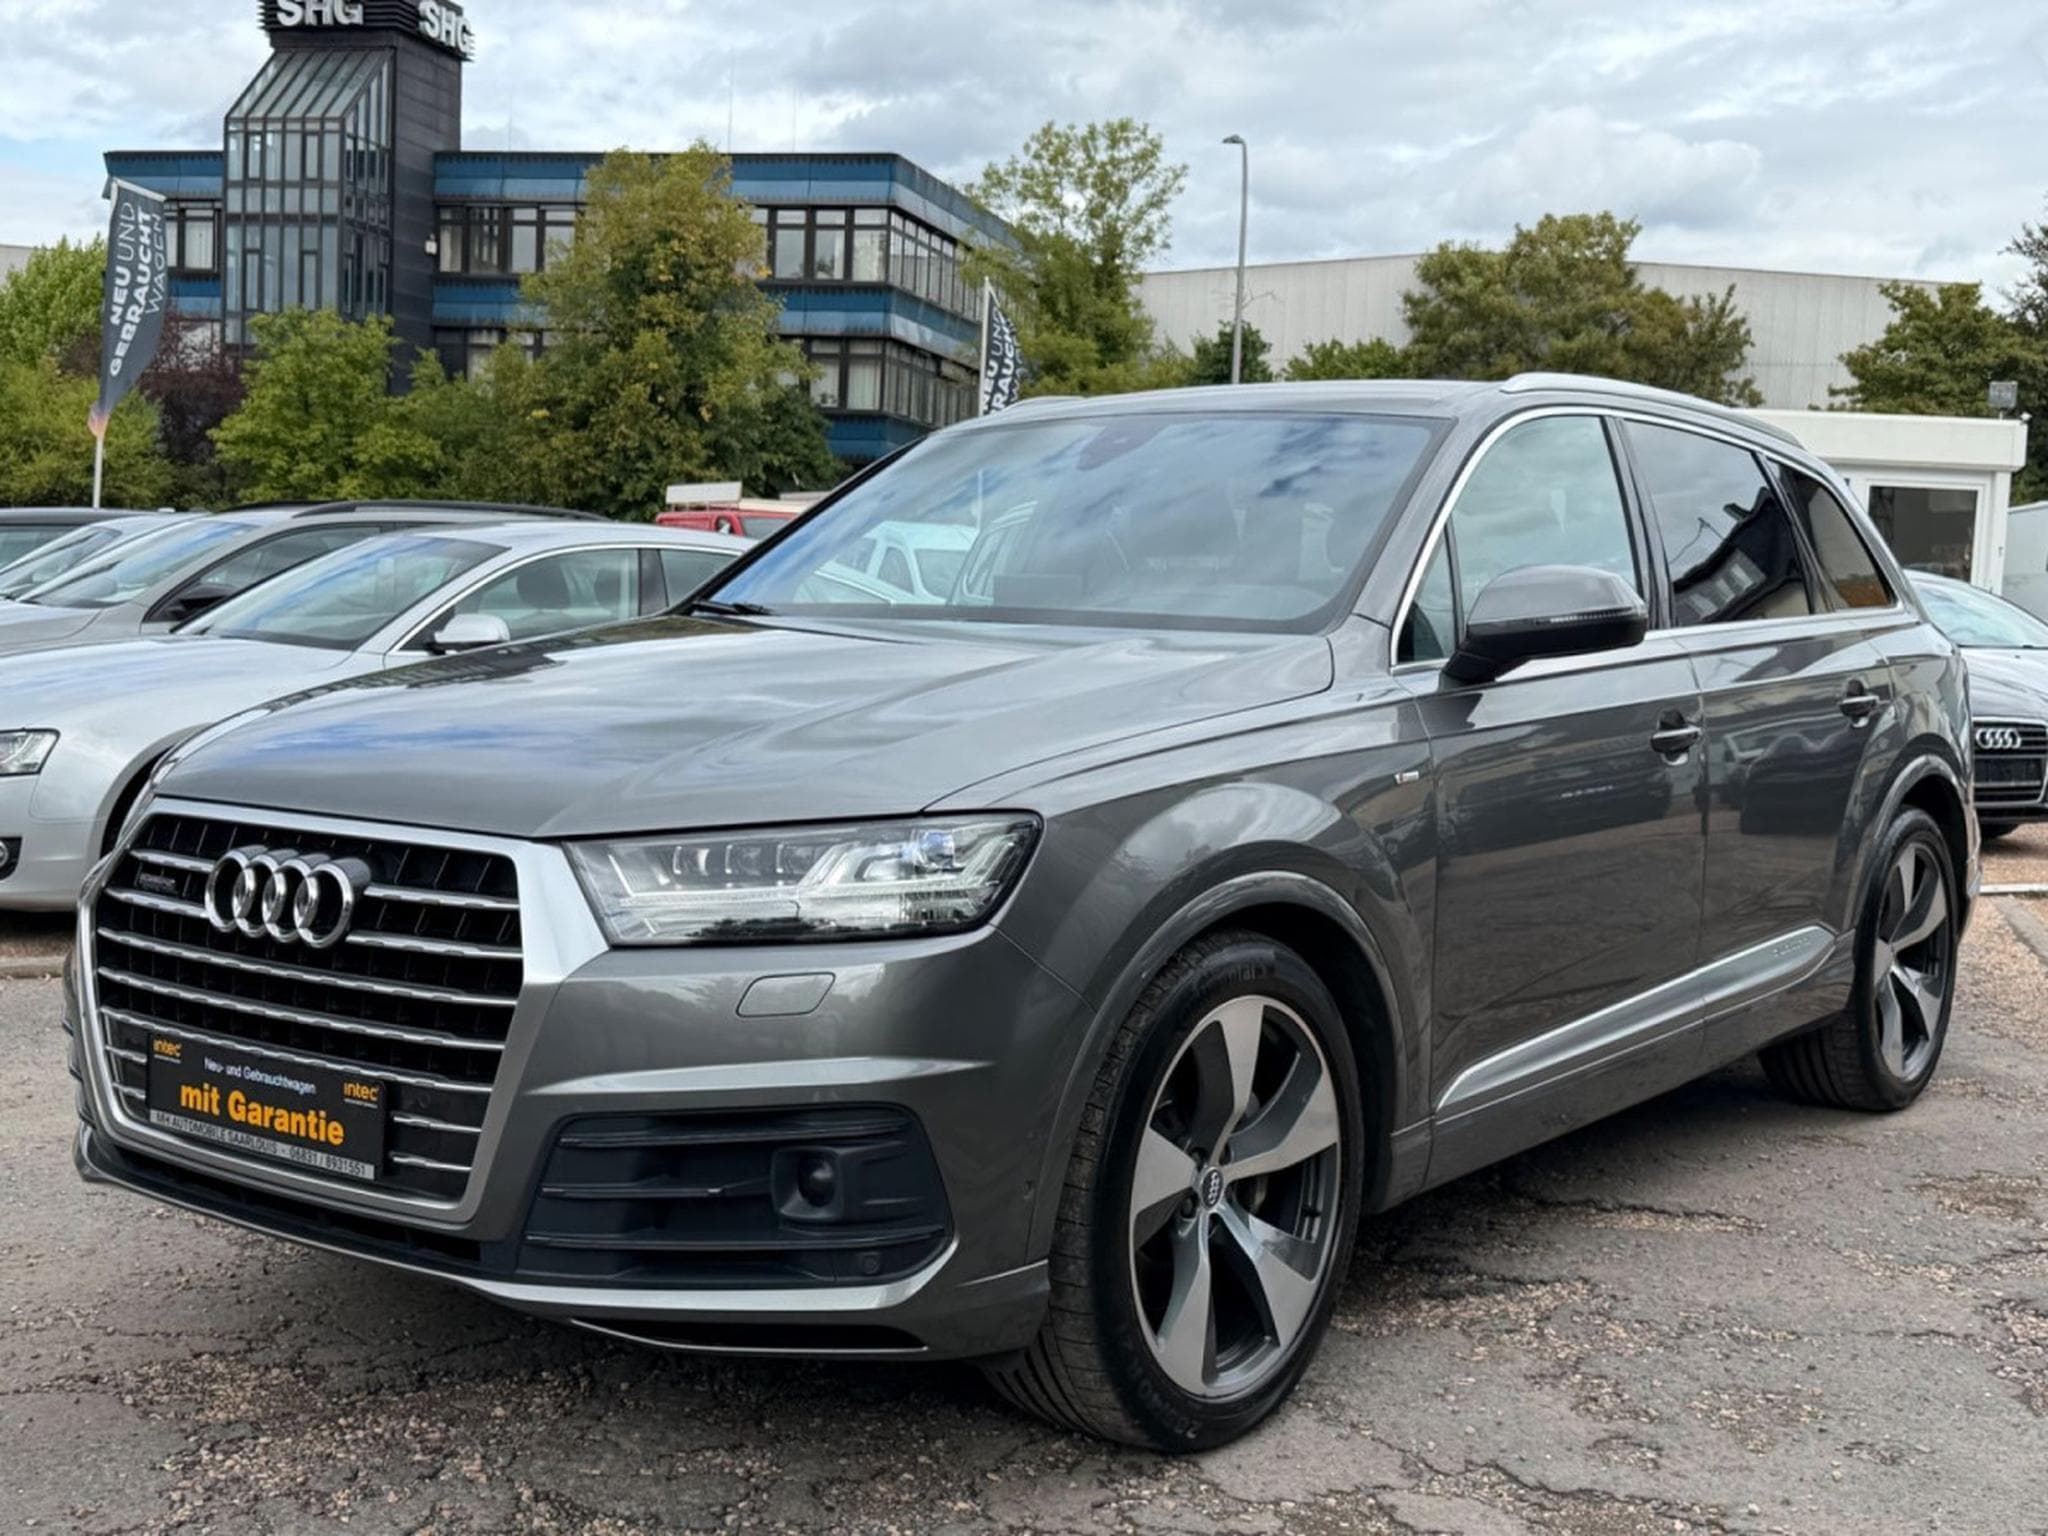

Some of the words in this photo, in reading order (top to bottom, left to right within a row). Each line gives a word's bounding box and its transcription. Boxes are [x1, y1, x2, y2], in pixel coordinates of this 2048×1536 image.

[277, 0, 364, 26] SHG
[418, 0, 474, 53] SHG
[116, 201, 137, 262] UND
[110, 205, 153, 377] GEBRAUCHT
[110, 266, 132, 326] NEU
[153, 1038, 182, 1057] intec
[203, 1056, 225, 1074] Neu-
[226, 1064, 242, 1078] und
[243, 1066, 317, 1096] Gebrauchtwagen
[343, 1081, 379, 1102] intec
[180, 1082, 221, 1117] mit
[227, 1089, 345, 1146] Garantie
